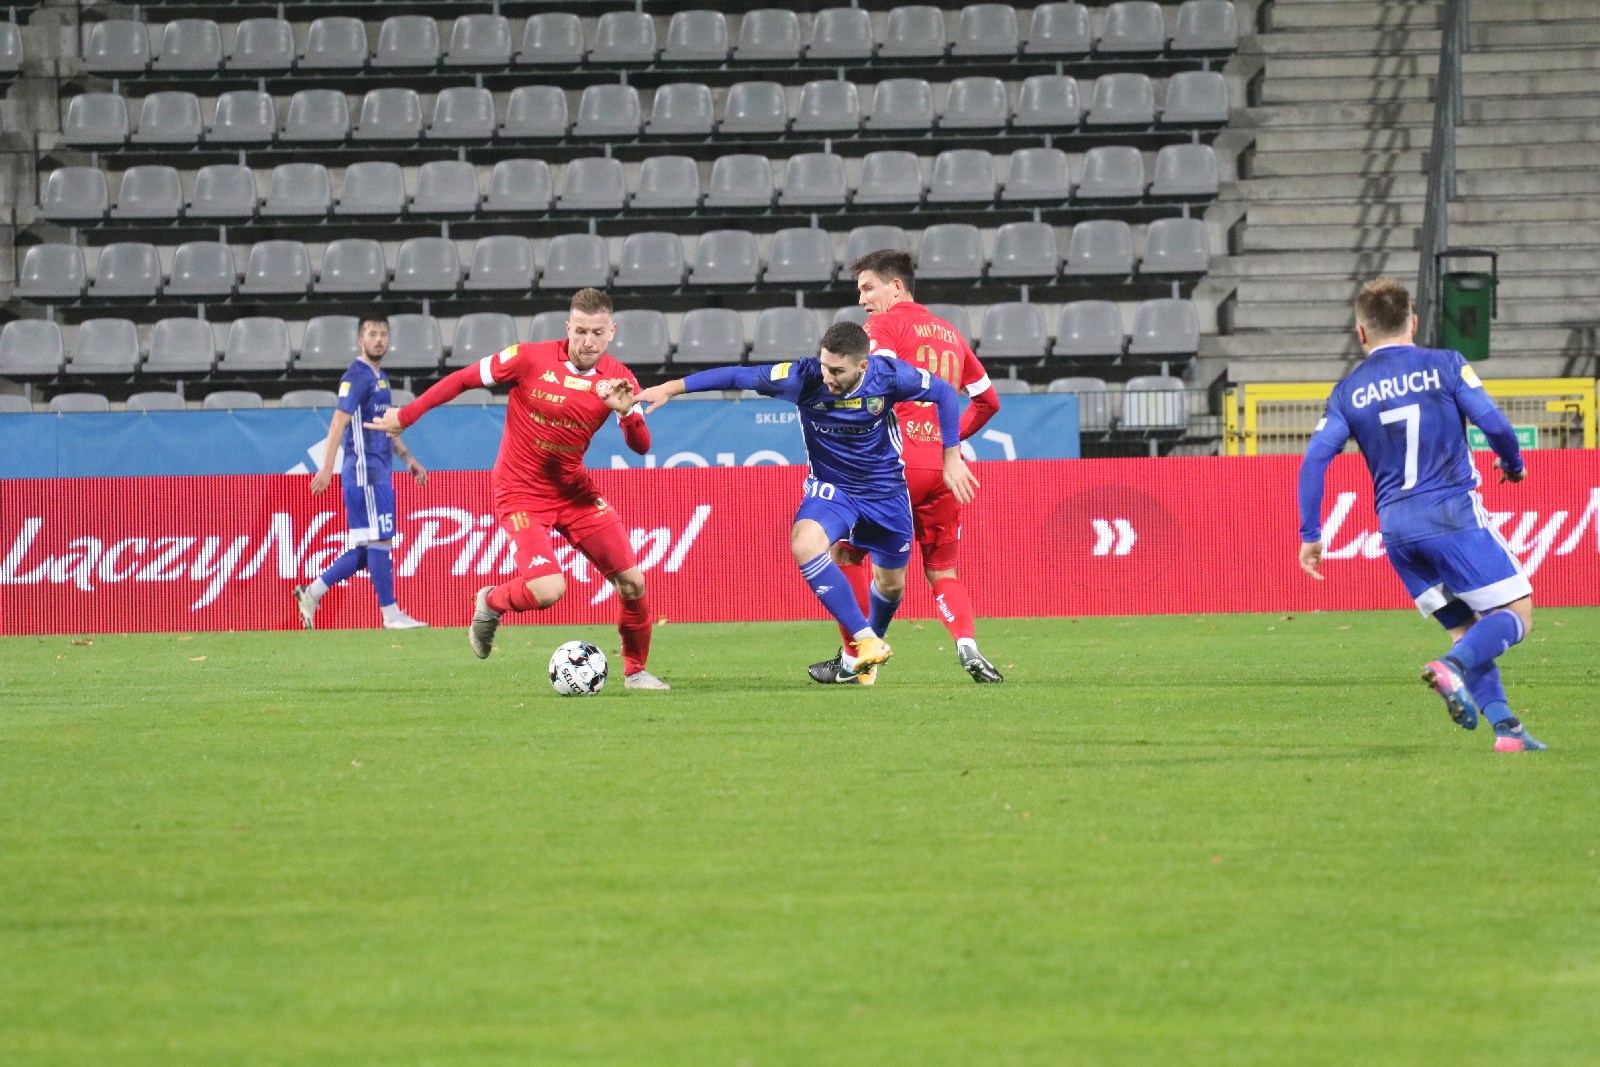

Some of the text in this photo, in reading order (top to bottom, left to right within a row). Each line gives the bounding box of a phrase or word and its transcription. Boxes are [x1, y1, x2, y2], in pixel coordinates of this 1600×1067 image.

[1351, 368, 1441, 409] GARUCH
[755, 412, 801, 424] SKLEP
[1379, 403, 1420, 490] 7
[811, 481, 835, 500] 10
[377, 513, 393, 533] 15
[509, 512, 530, 532] 16
[561, 668, 584, 694] SELECT
